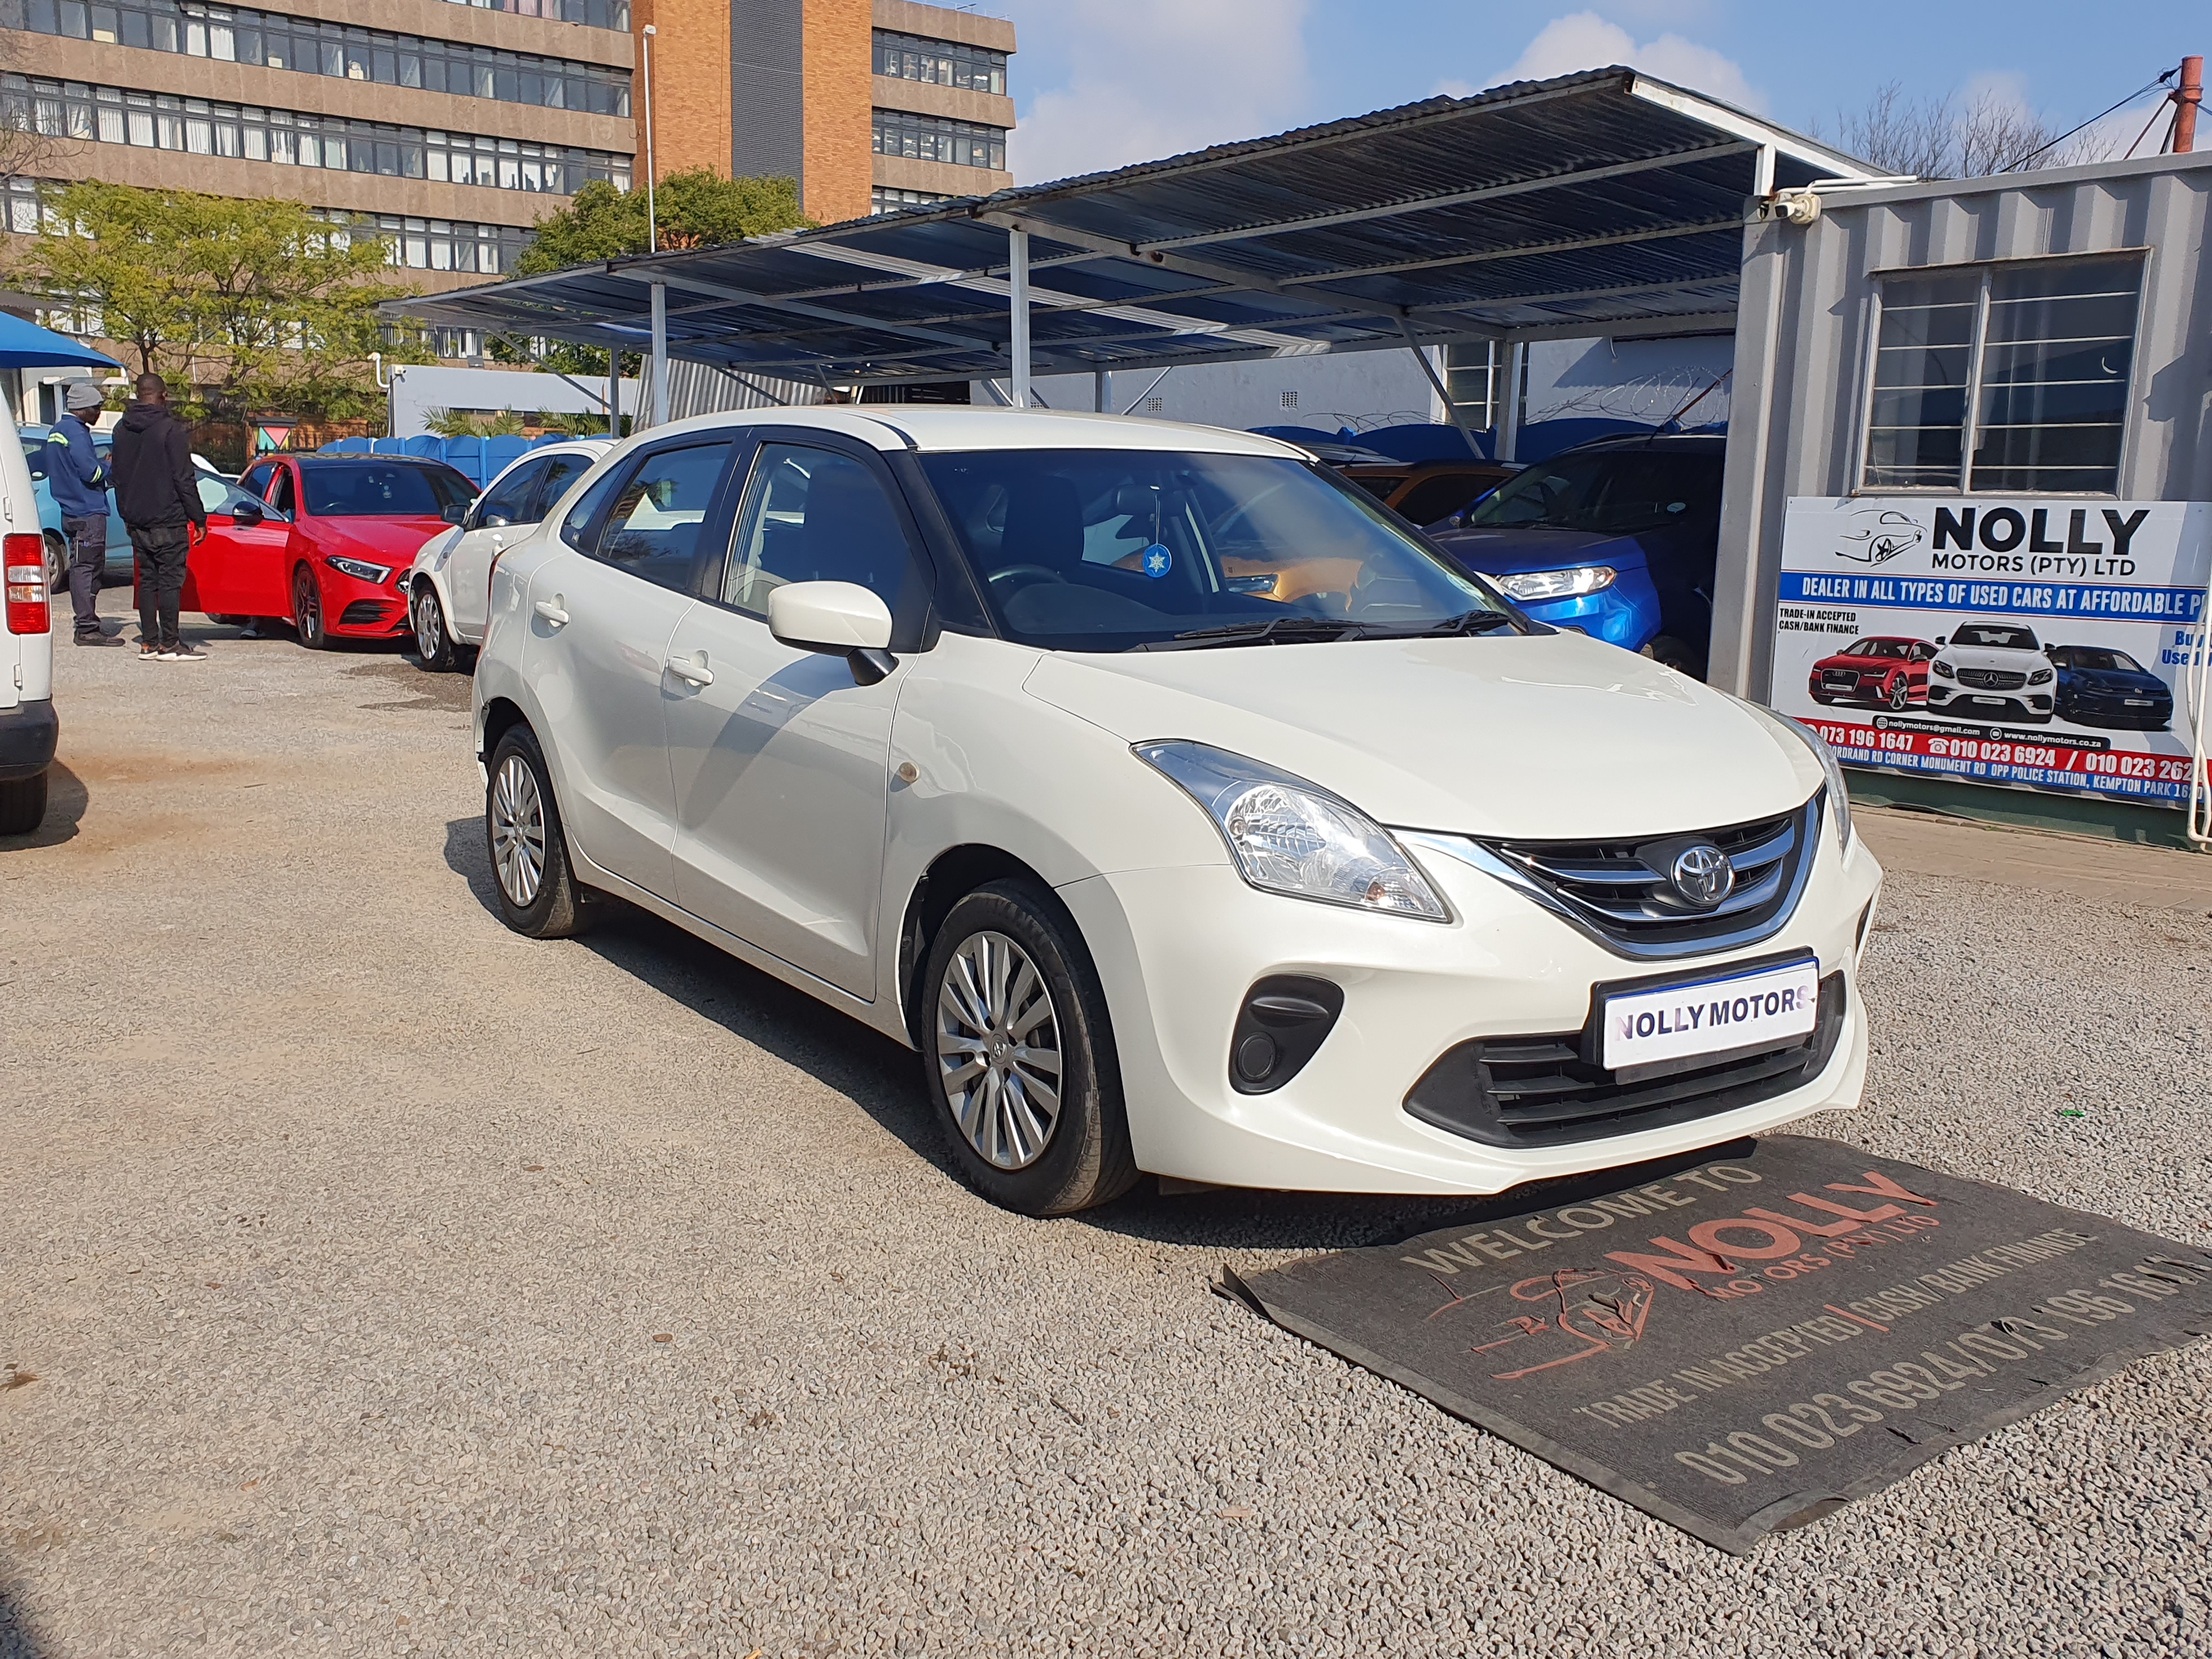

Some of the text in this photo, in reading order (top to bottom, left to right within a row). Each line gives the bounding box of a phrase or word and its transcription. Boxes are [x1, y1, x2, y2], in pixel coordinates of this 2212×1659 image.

[1932, 506, 2151, 555] NOLLY
[1932, 554, 2136, 577] MOTORS (PTY) LTD
[1802, 577, 1849, 598] DEALER
[1853, 579, 1866, 599] IN
[1871, 580, 1895, 600] ALL
[1900, 582, 1943, 603] TYPES
[1948, 584, 1966, 603] OF
[1970, 585, 2008, 606] USED
[2012, 587, 2052, 608] CARS
[2056, 589, 2077, 610] AT
[2080, 590, 2185, 614] AFFORDABLE
[1779, 620, 1859, 635] CASH/BANK FINANCE
[1780, 608, 1856, 622] TRADE-IN ACCEPTED
[1820, 726, 1914, 751] 073 196 1647
[1888, 720, 1980, 736] nollymotors@gmail.com
[2004, 732, 2101, 748] www.nollymotors.co.za
[1830, 746, 2203, 799] ORDRAND RD CORNER MONUMENT RD OPP POLICE STATION, KEMPTON PARK 160
[1950, 739, 1978, 758] 010
[1980, 742, 2011, 762] 023
[2014, 746, 2056, 766] 6924
[2086, 753, 2117, 773] 010
[2121, 756, 2155, 777] 023
[2159, 760, 2199, 782] 262
[1400, 1166, 1762, 1274] WELCOME TO
[1604, 1170, 1938, 1291] NOLLY
[1883, 1216, 1940, 1234] LTD
[1572, 1379, 1699, 1429] TRADE
[1671, 1365, 1733, 1392] IN
[1709, 1315, 1864, 1379] ACCEPTED
[1982, 1228, 2098, 1268] FINANCE
[1674, 1431, 1799, 1484] 010
[1762, 1393, 1884, 1449] 023
[2031, 1289, 2136, 1327] 196
